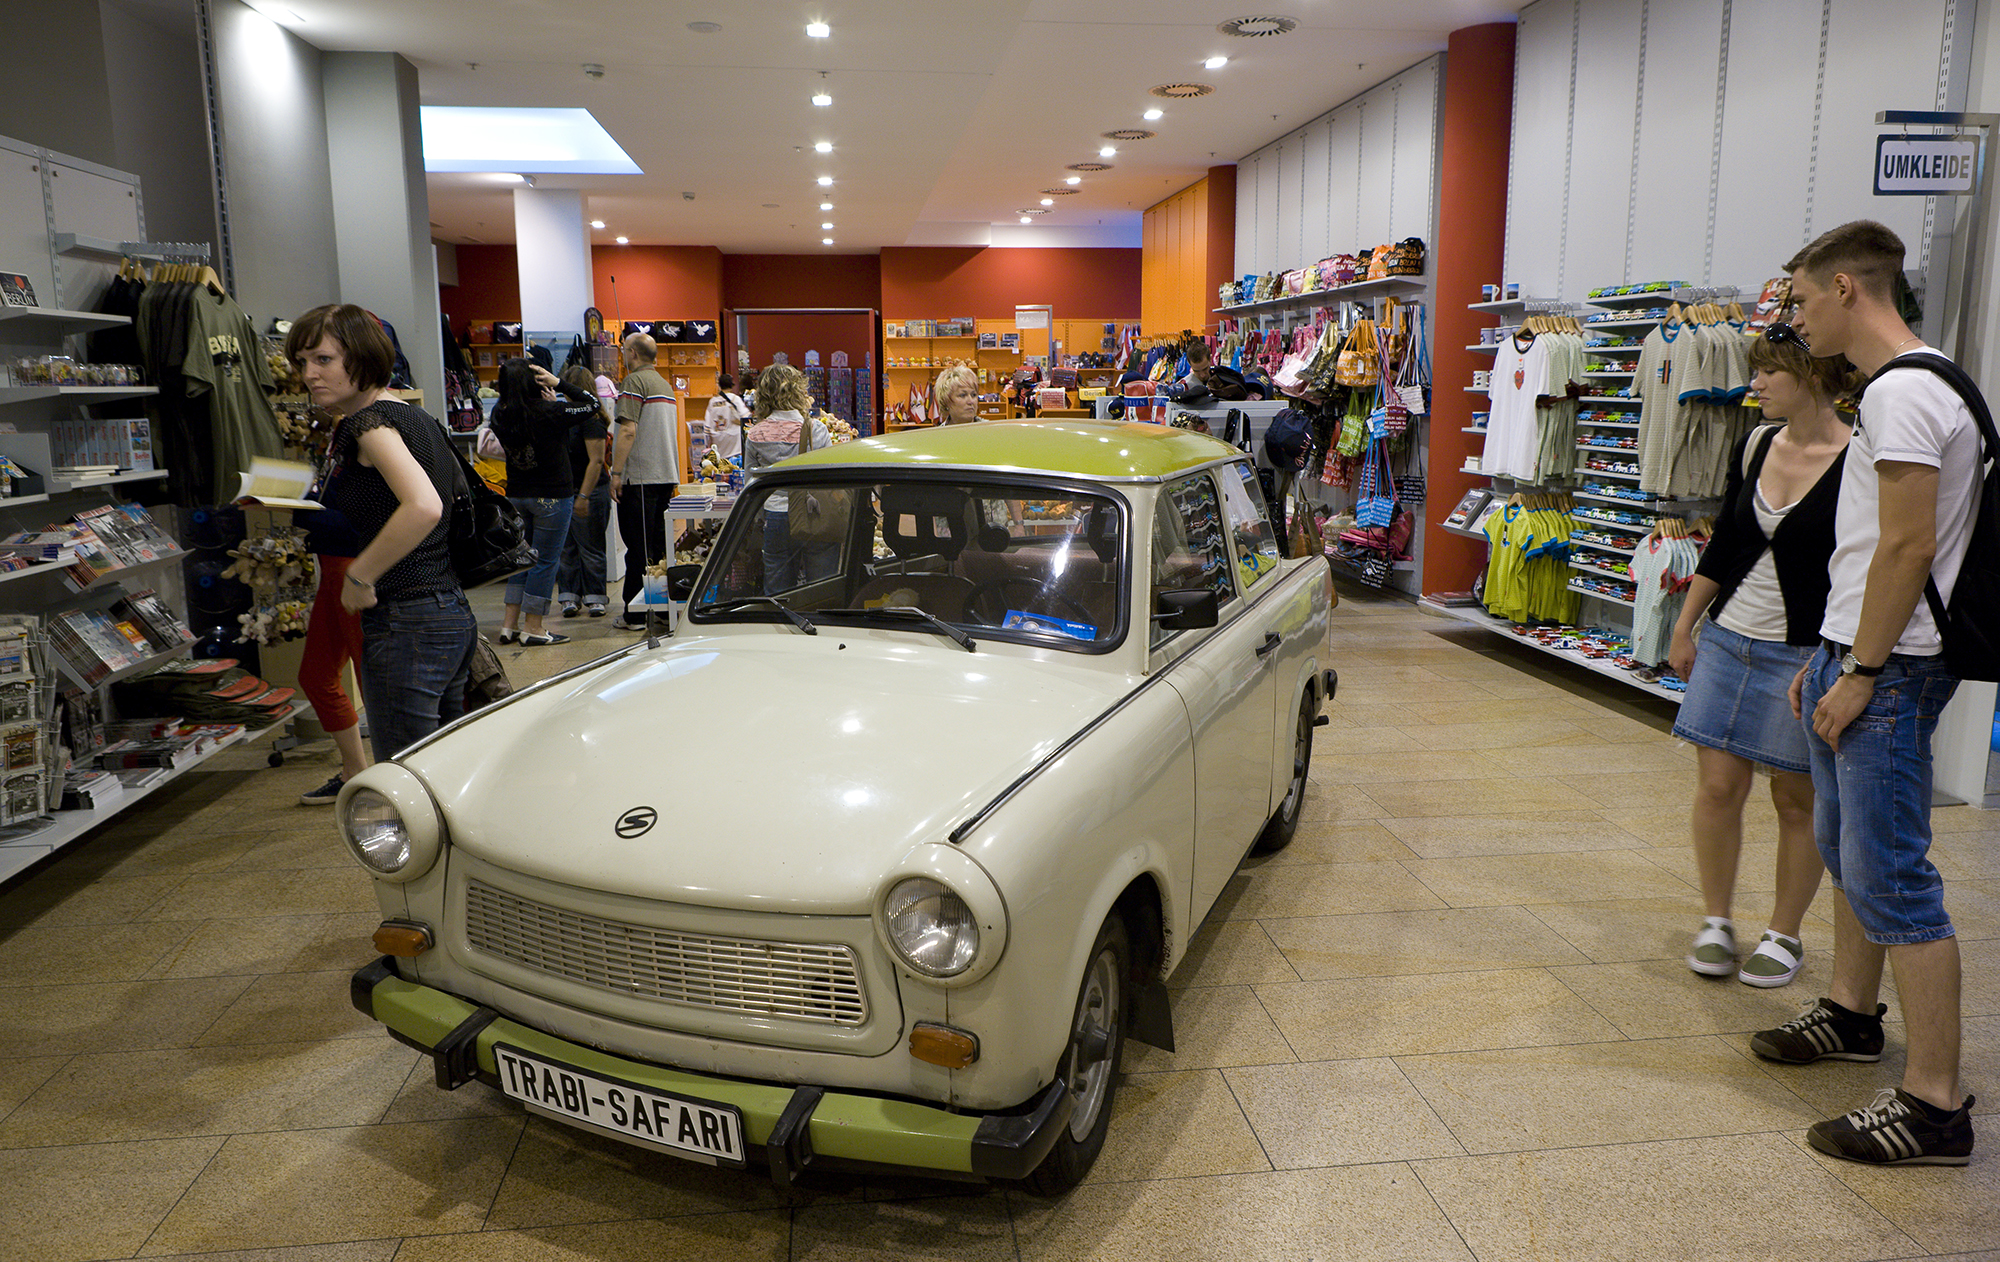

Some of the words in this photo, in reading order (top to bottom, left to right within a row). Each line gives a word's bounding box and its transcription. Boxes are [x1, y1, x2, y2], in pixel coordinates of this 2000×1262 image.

[1883, 154, 1971, 179] UMKLEIDE
[5, 291, 36, 306] BERLIN
[501, 1053, 733, 1154] TRABI-SAFARI
